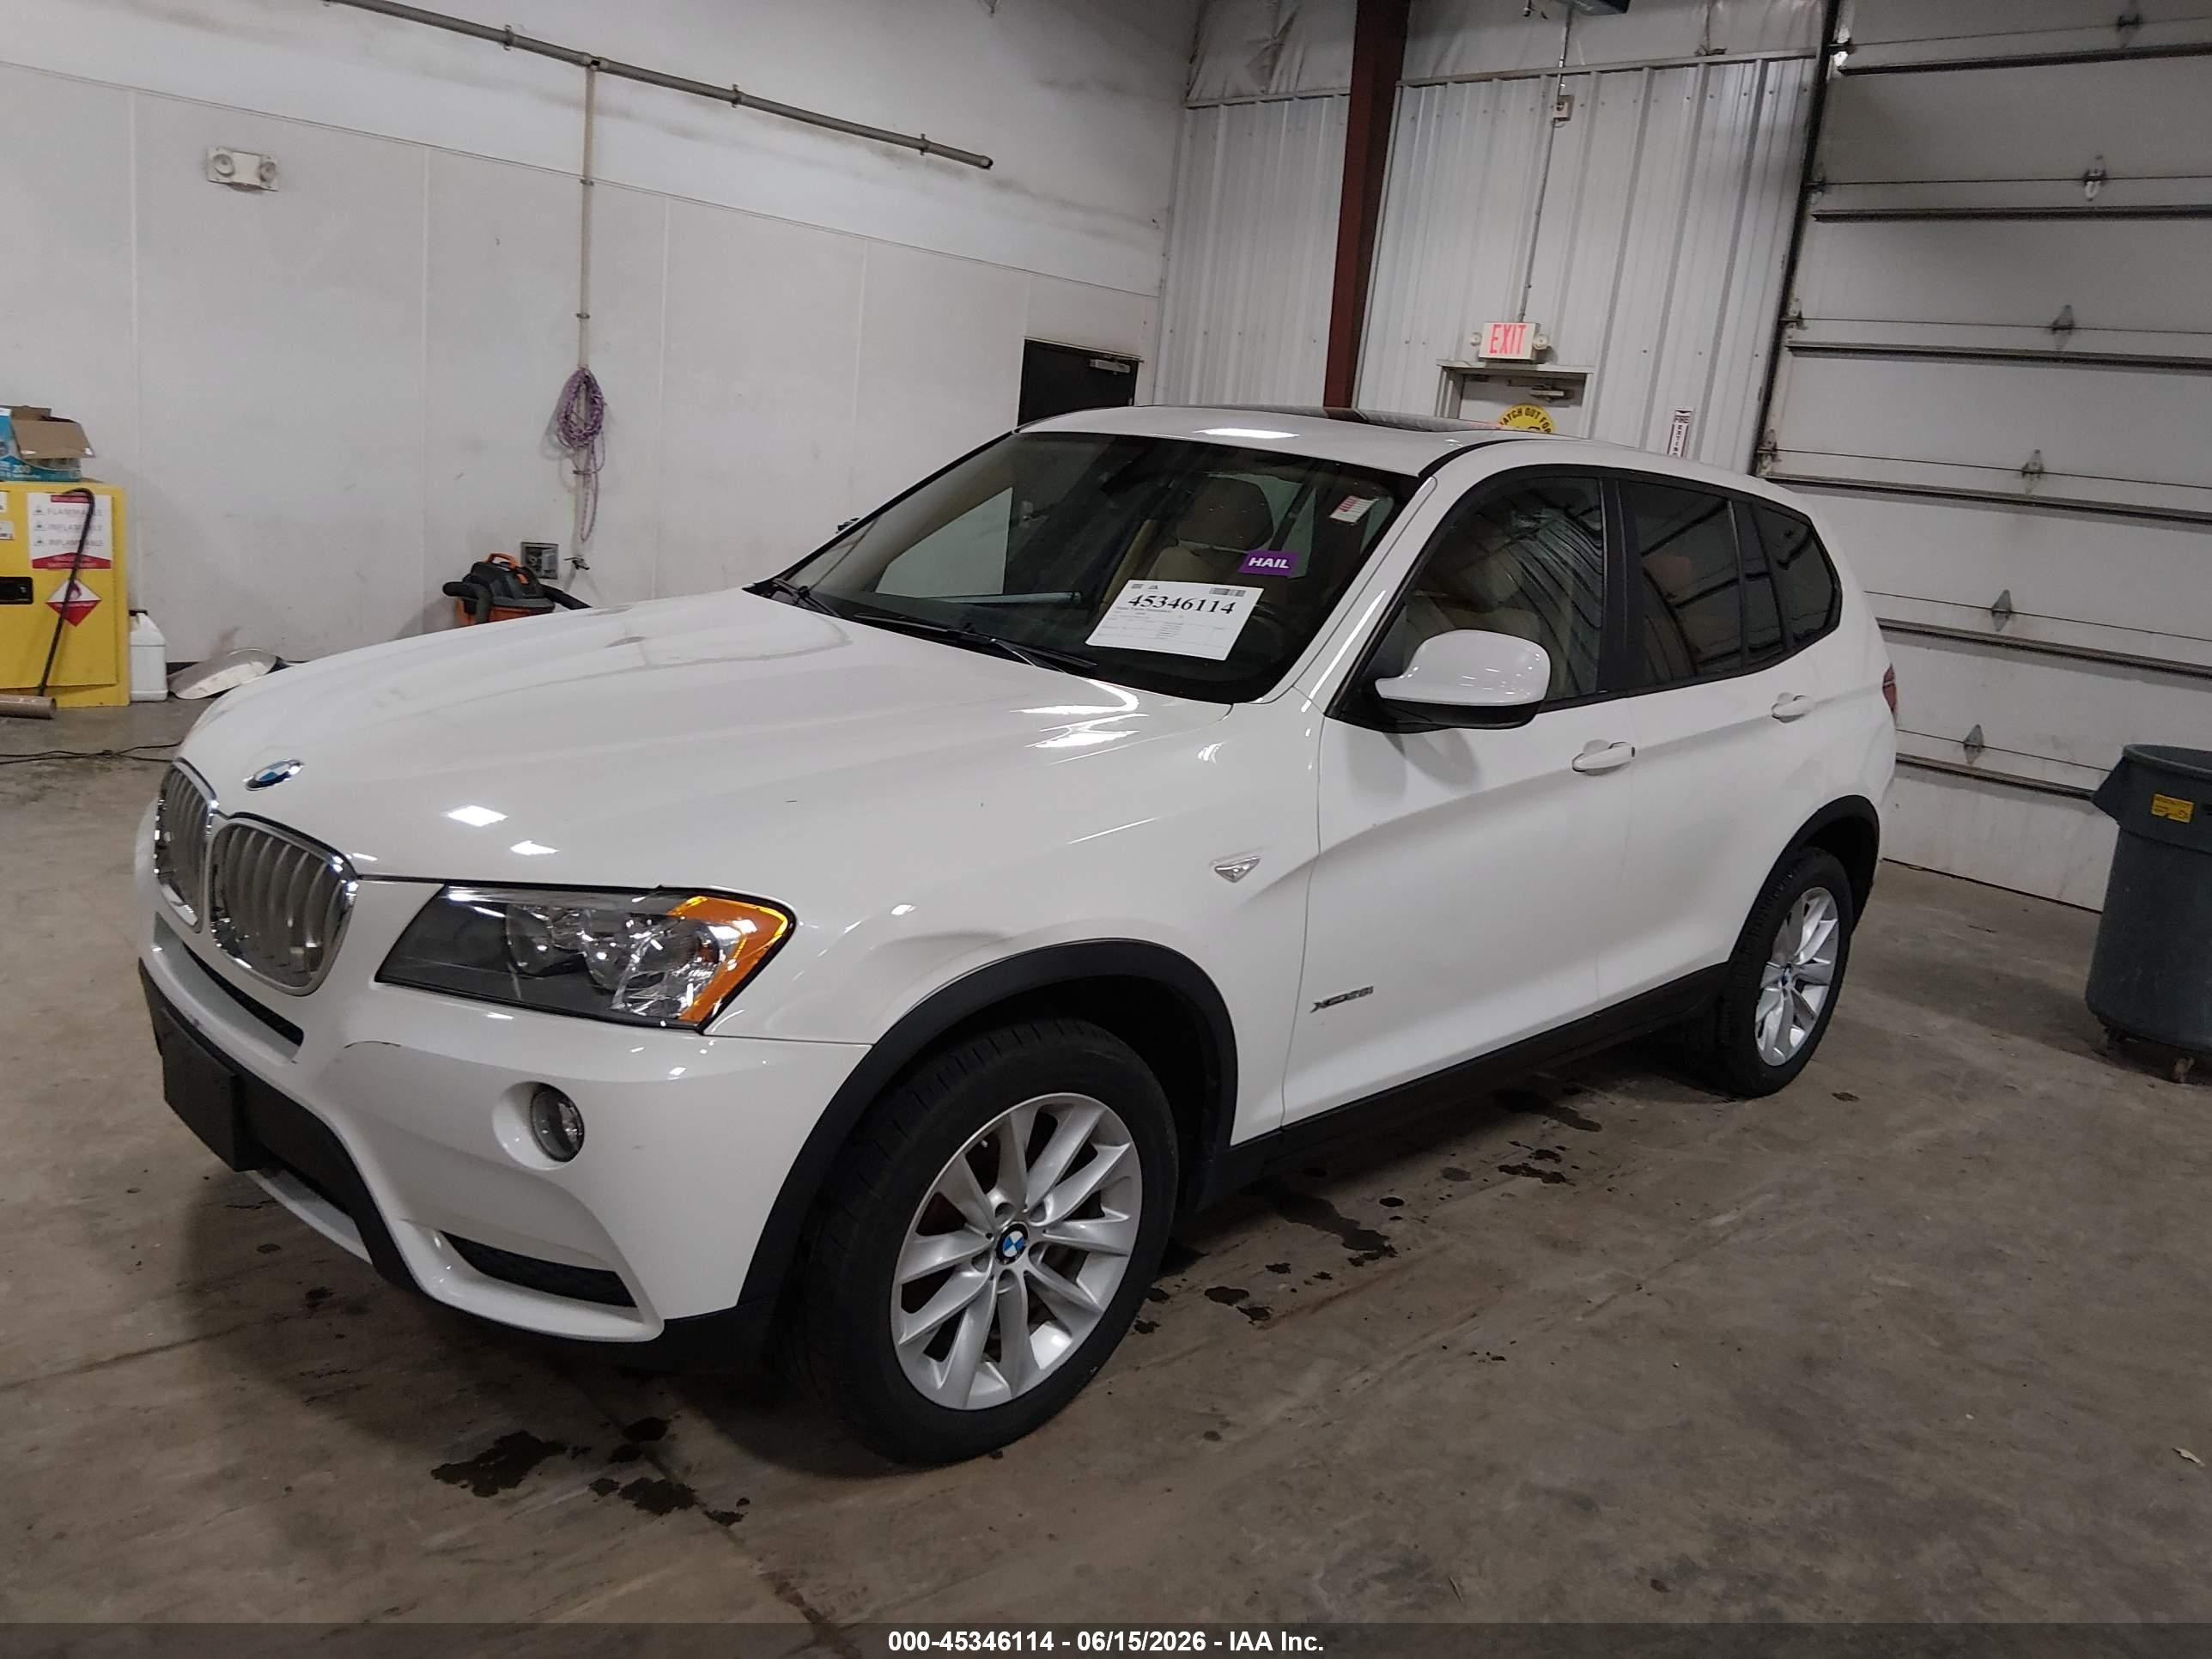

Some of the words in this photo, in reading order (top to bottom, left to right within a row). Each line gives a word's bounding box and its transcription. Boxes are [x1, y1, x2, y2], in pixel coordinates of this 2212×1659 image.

[1489, 323, 1527, 355] EXIT
[1524, 407, 1541, 420] OUT
[1248, 557, 1290, 568] HAIL
[1127, 594, 1237, 615] 45346114
